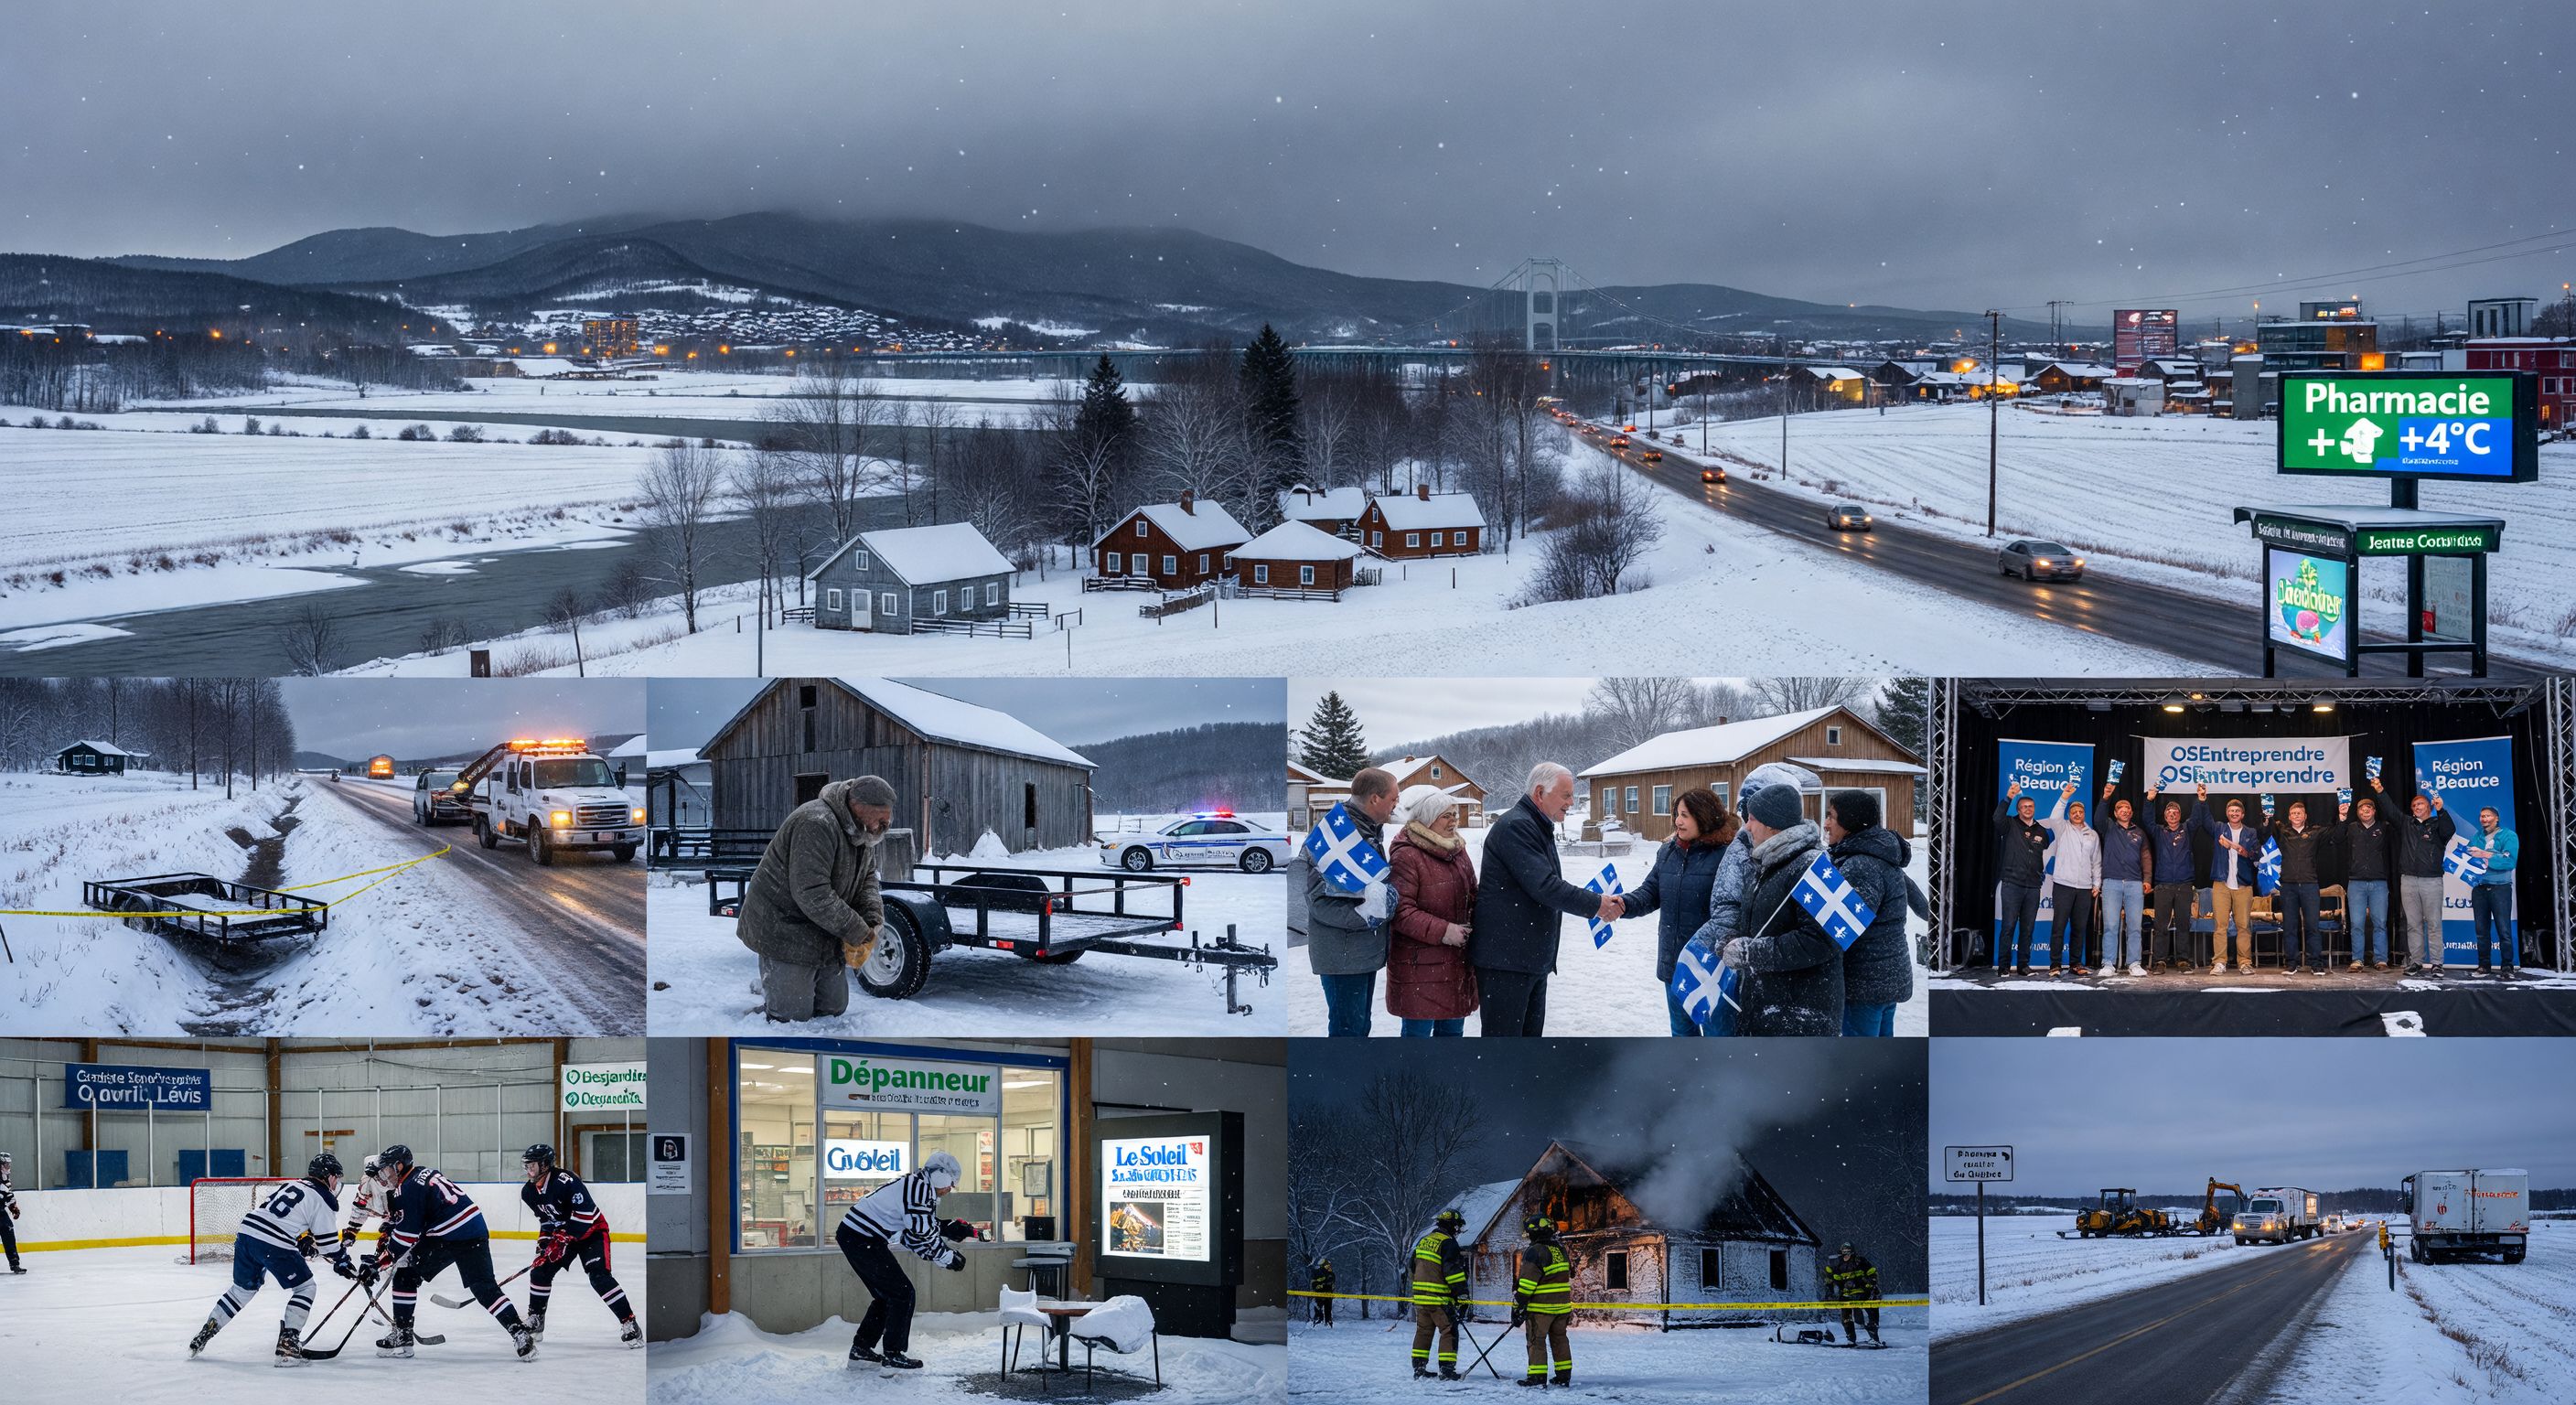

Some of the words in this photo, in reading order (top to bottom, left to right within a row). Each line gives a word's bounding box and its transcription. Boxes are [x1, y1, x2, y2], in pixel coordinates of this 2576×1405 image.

[2306, 382, 2490, 414] Pharmacie
[2171, 745, 2324, 766] OSEntreprendre
[2015, 758, 2064, 776] Région
[2432, 757, 2483, 776] Région
[2020, 775, 2072, 790] Beauc
[2436, 775, 2500, 790] Beauce
[831, 1058, 991, 1093] Dépanneur
[1115, 1146, 1139, 1166] Le
[1140, 1143, 1188, 1166] Soleil
